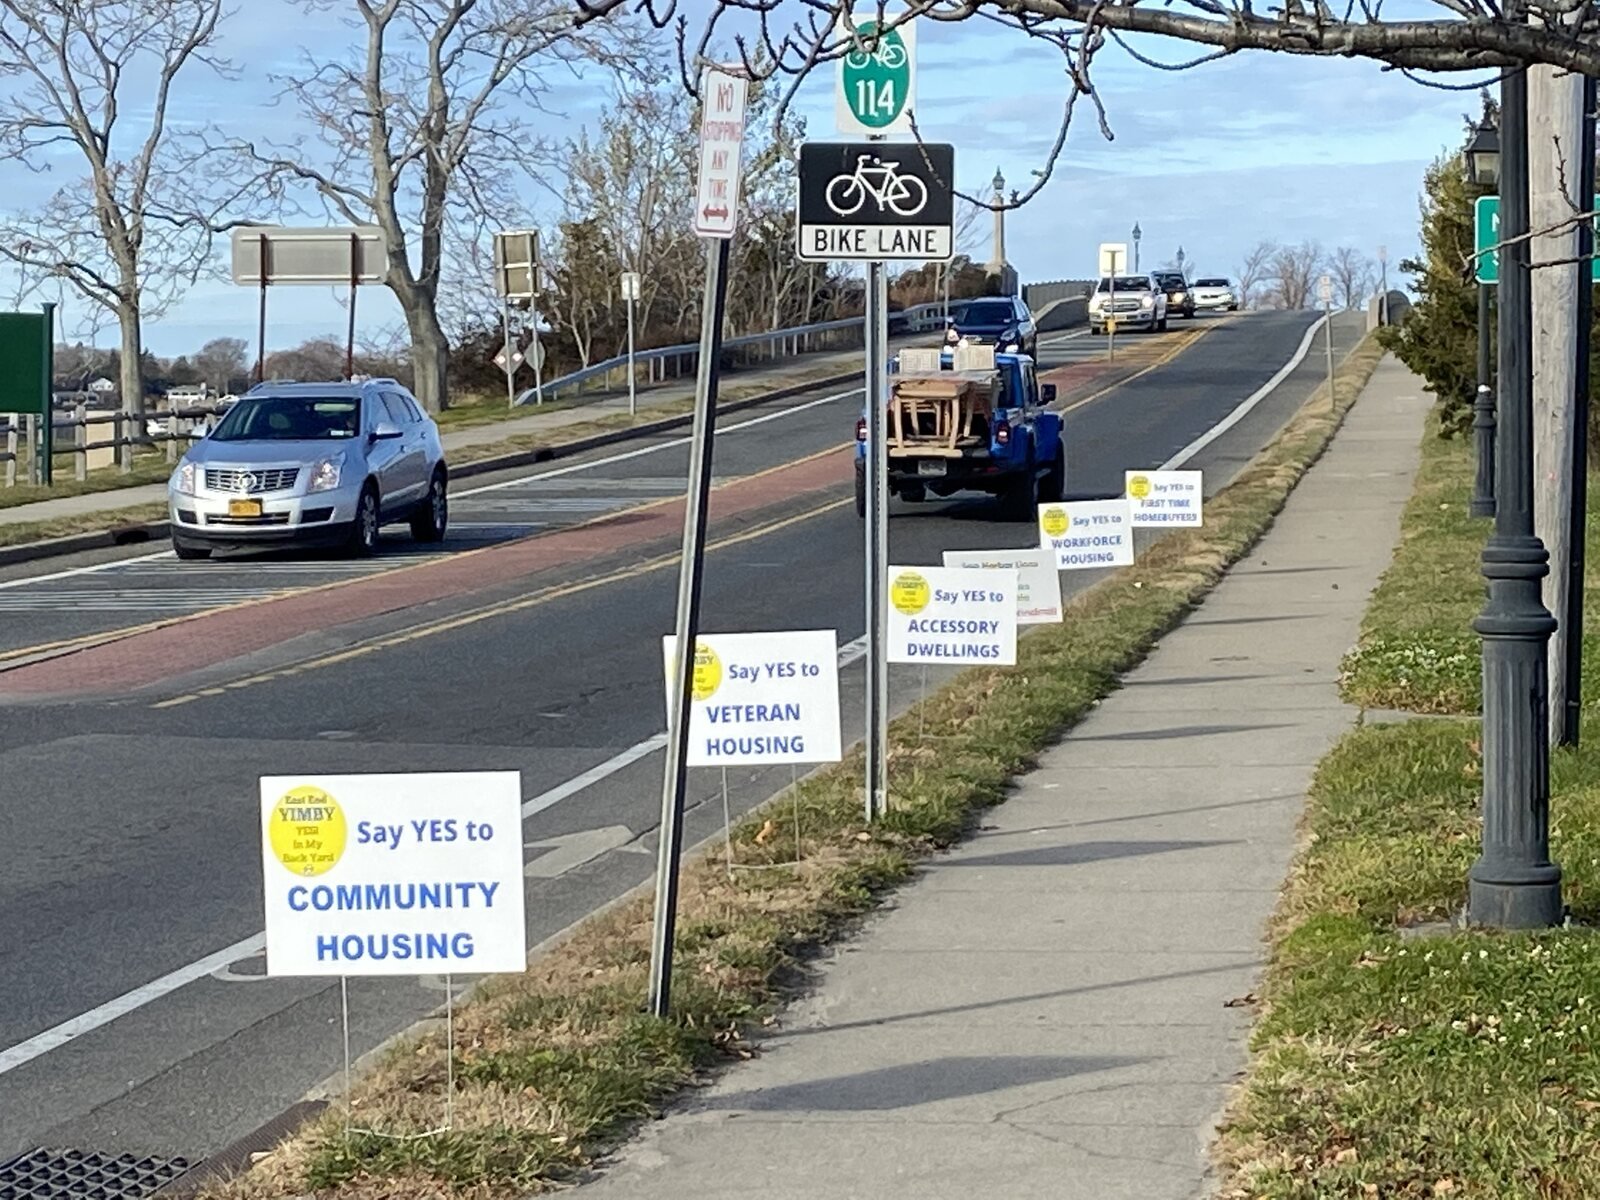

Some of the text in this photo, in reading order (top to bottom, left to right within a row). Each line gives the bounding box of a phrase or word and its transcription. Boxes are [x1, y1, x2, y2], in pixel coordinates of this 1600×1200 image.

[716, 82, 734, 112] NO
[855, 79, 896, 117] 114
[705, 121, 742, 142] STOPPING
[711, 149, 729, 169] ANY
[708, 178, 729, 200] TIME
[814, 228, 938, 253] BIKE LANE
[1154, 483, 1168, 492] Say
[1169, 483, 1184, 491] YES
[1141, 499, 1190, 508] FIRST TIME
[1072, 516, 1090, 527] Say
[1092, 515, 1109, 524] YES
[1111, 515, 1122, 523] to
[1133, 513, 1197, 521] HOMEBUYERS
[1051, 535, 1122, 548] WORKFORCE
[1061, 552, 1114, 565] HOUSING
[934, 589, 959, 604] Say
[962, 590, 986, 602] YES
[989, 590, 1004, 602] to
[908, 619, 999, 634] ACCESSORY
[907, 643, 1000, 658] DWELLINGS
[729, 662, 820, 684] Say YES to
[706, 703, 801, 724] VETERAN
[706, 735, 805, 757] HOUSING
[278, 807, 336, 822] YIMBY
[357, 819, 494, 850] Say YES to
[288, 881, 500, 912] COMMUNITY
[316, 932, 475, 961] HOUSING
